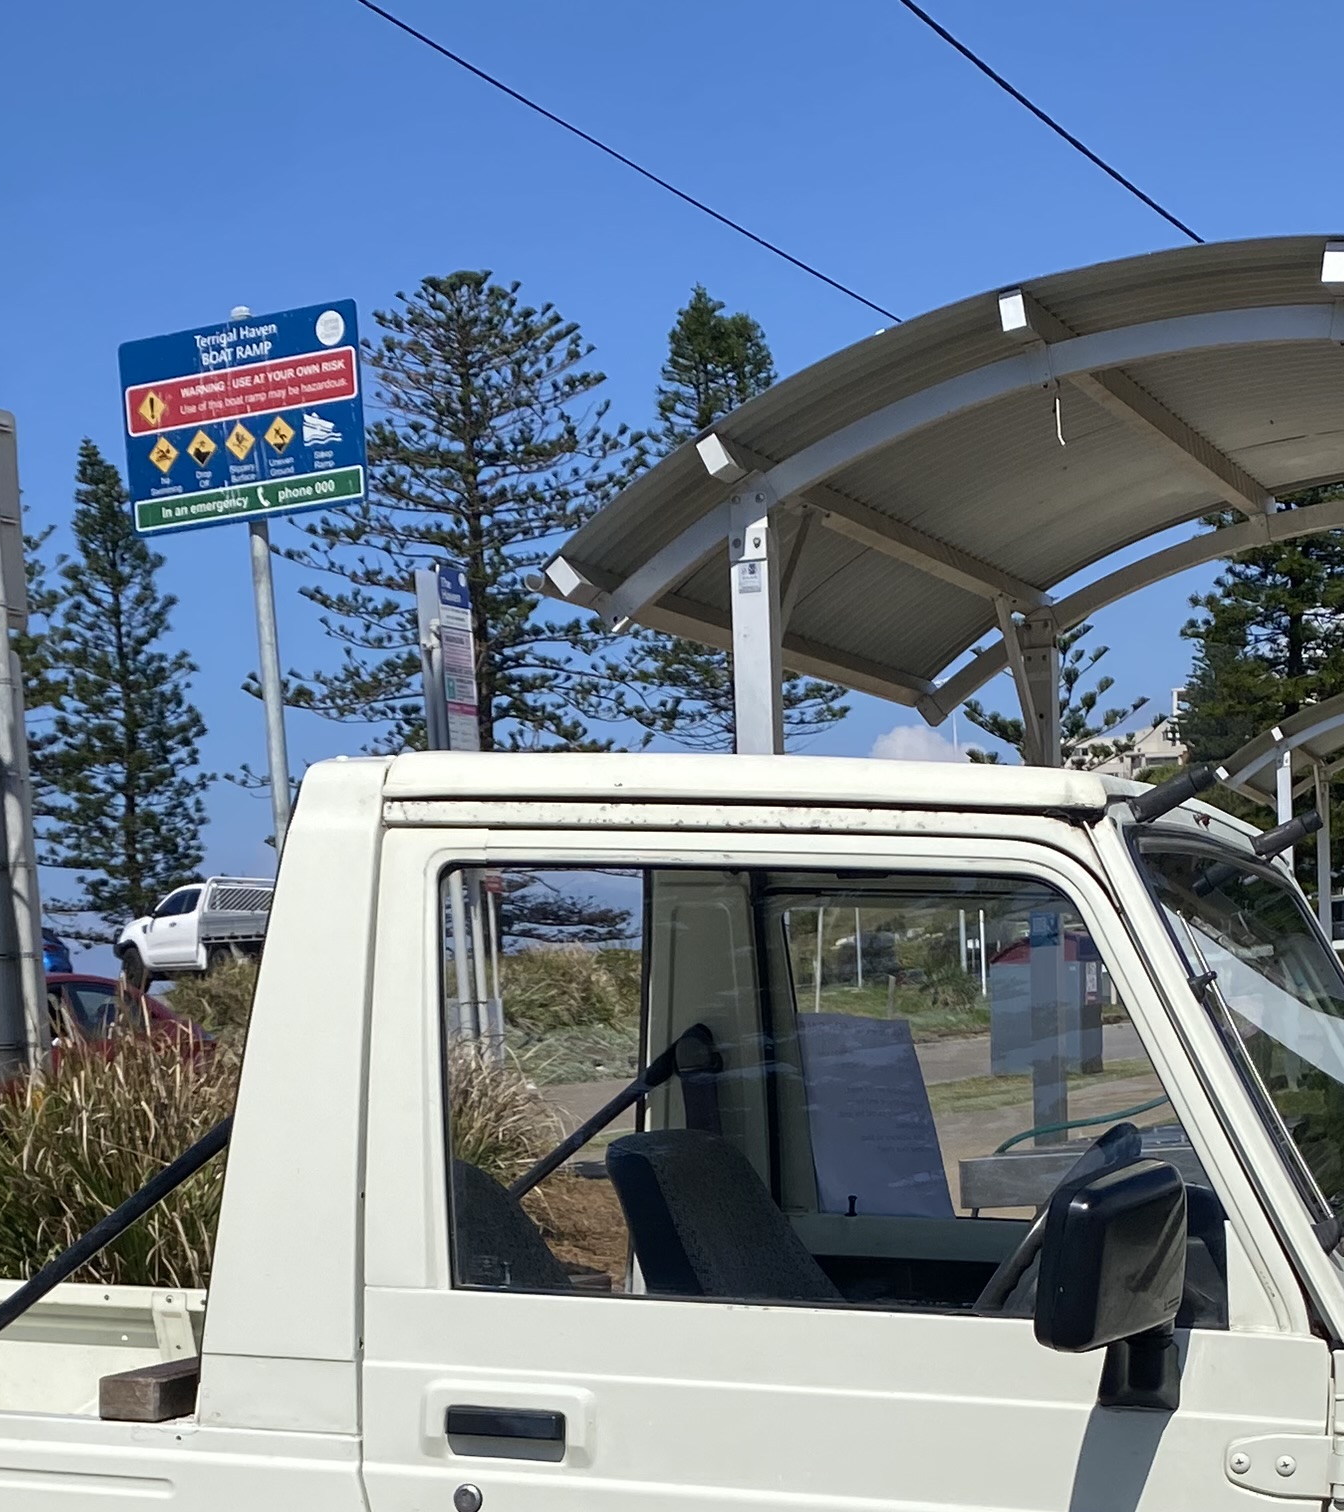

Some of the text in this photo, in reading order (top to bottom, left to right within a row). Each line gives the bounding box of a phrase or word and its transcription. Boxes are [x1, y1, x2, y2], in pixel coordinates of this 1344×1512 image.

[194, 324, 277, 347] Terrigal Haven
[202, 341, 272, 365] BOAT RAMP
[180, 359, 346, 398] WARNING USE AT YOUR OWN RISK
[180, 404, 197, 415] Use
[198, 400, 207, 411] of
[208, 400, 223, 409] this
[224, 395, 244, 406] boat
[245, 391, 267, 403] ramp
[268, 389, 286, 399] may
[288, 386, 299, 395] be
[162, 479, 335, 518] In an emergency phone 000
